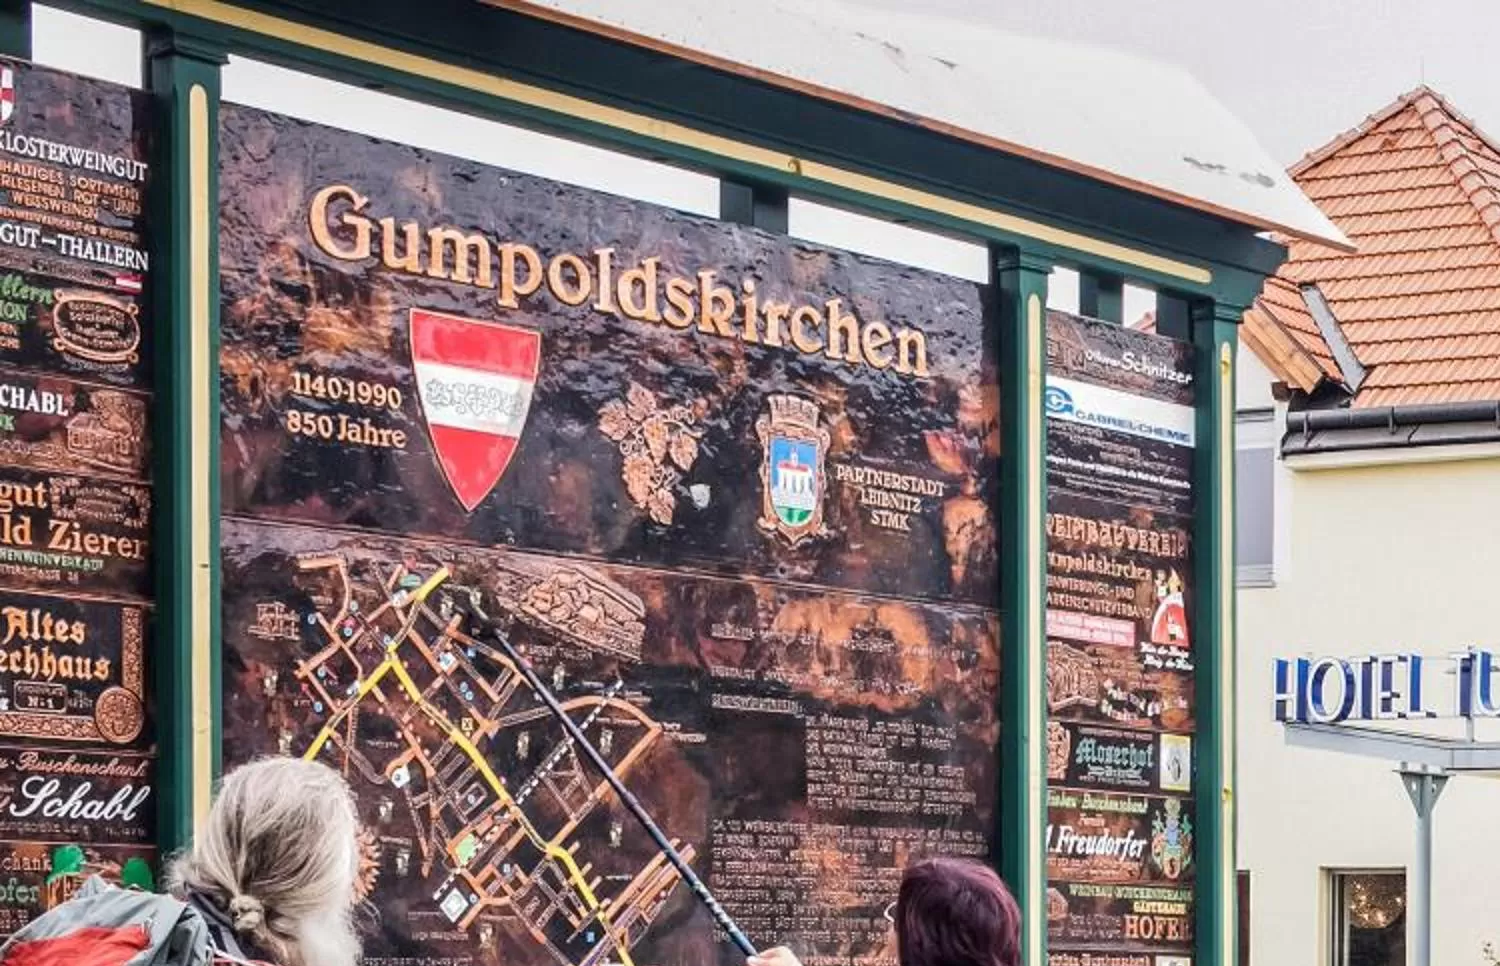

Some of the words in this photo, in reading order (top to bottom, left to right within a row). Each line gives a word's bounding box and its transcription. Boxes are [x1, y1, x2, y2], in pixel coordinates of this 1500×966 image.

[308, 184, 929, 378] Gumpoldskirchen
[290, 371, 402, 410] 1140-1990
[287, 409, 333, 438] 850
[337, 412, 407, 449] Jahre
[836, 463, 946, 497] PARTNERSTADT
[870, 508, 912, 532] STMK
[47, 519, 149, 561] Zierer
[2, 606, 86, 645] Altes
[1272, 653, 1436, 723] HOTEL
[9, 775, 151, 821] Schabl
[1057, 825, 1148, 863] Freudorfer
